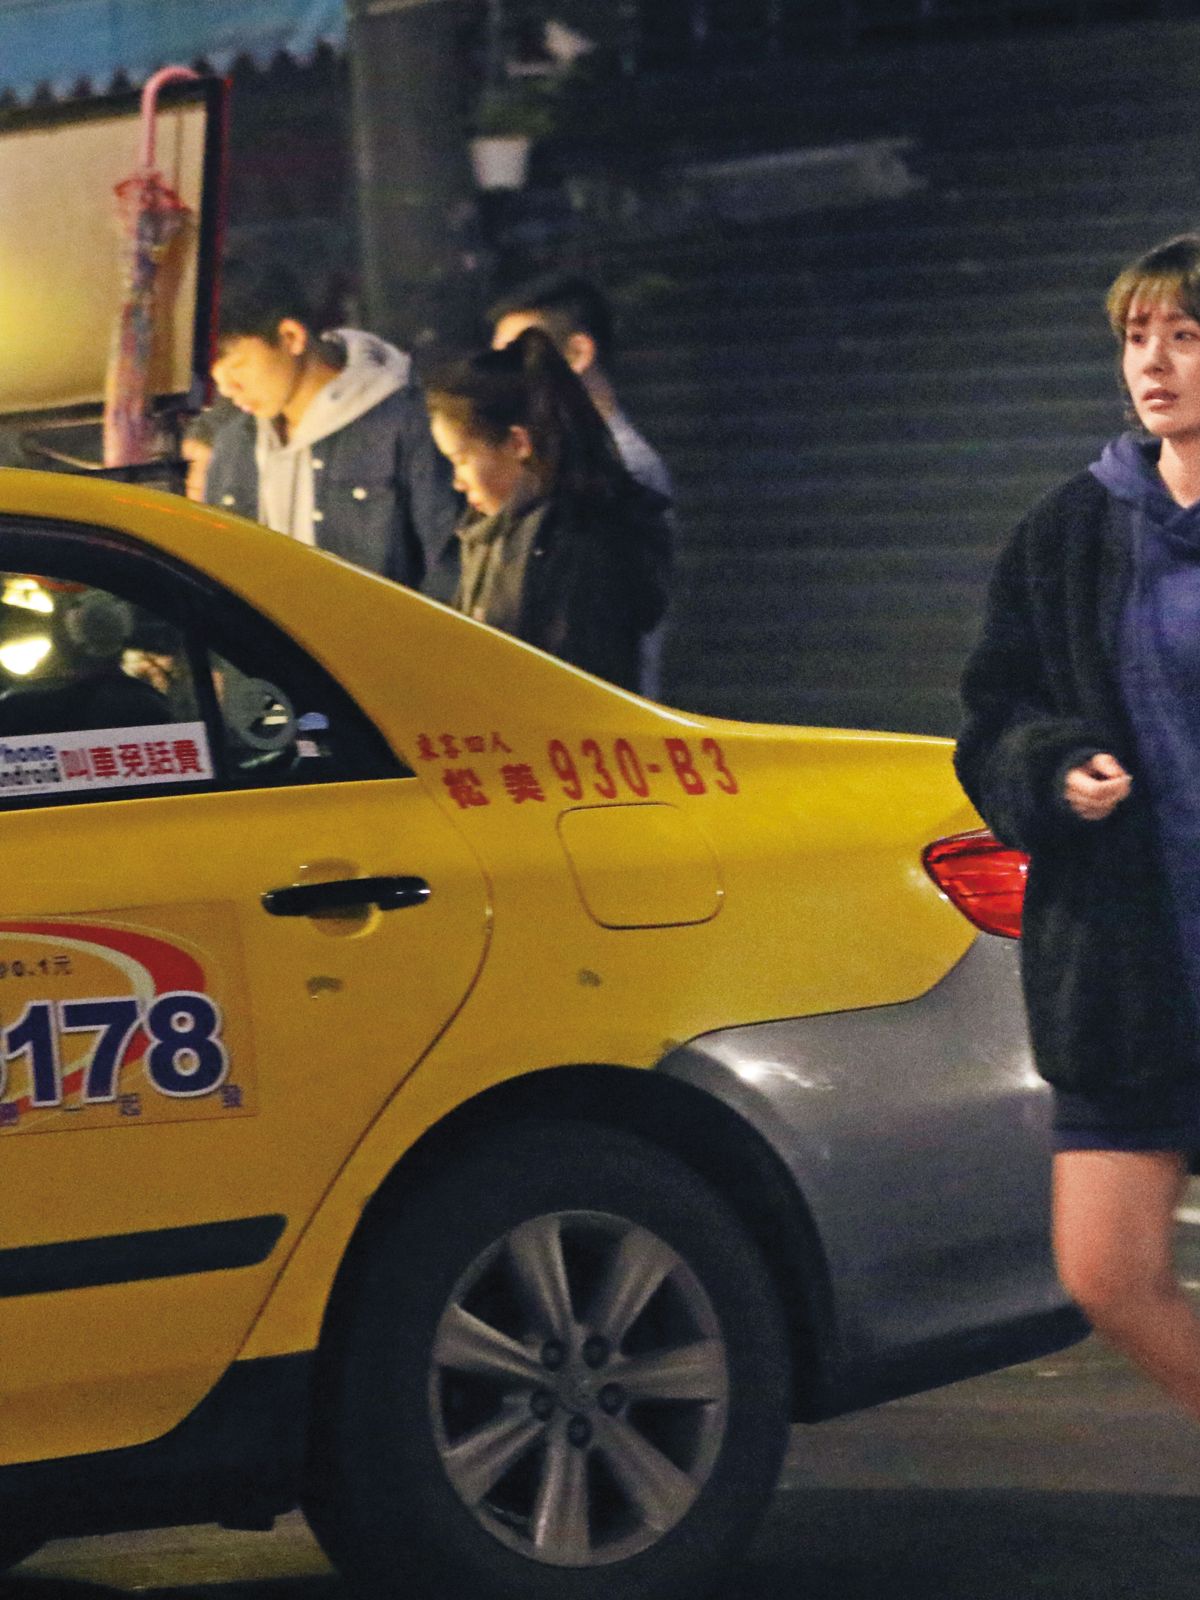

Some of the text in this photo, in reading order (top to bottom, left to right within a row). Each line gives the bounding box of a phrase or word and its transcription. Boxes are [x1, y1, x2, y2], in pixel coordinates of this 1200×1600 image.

[60, 739, 203, 781] 叫車免話費
[548, 738, 738, 801] 930-B3
[0, 990, 229, 1108] 178
